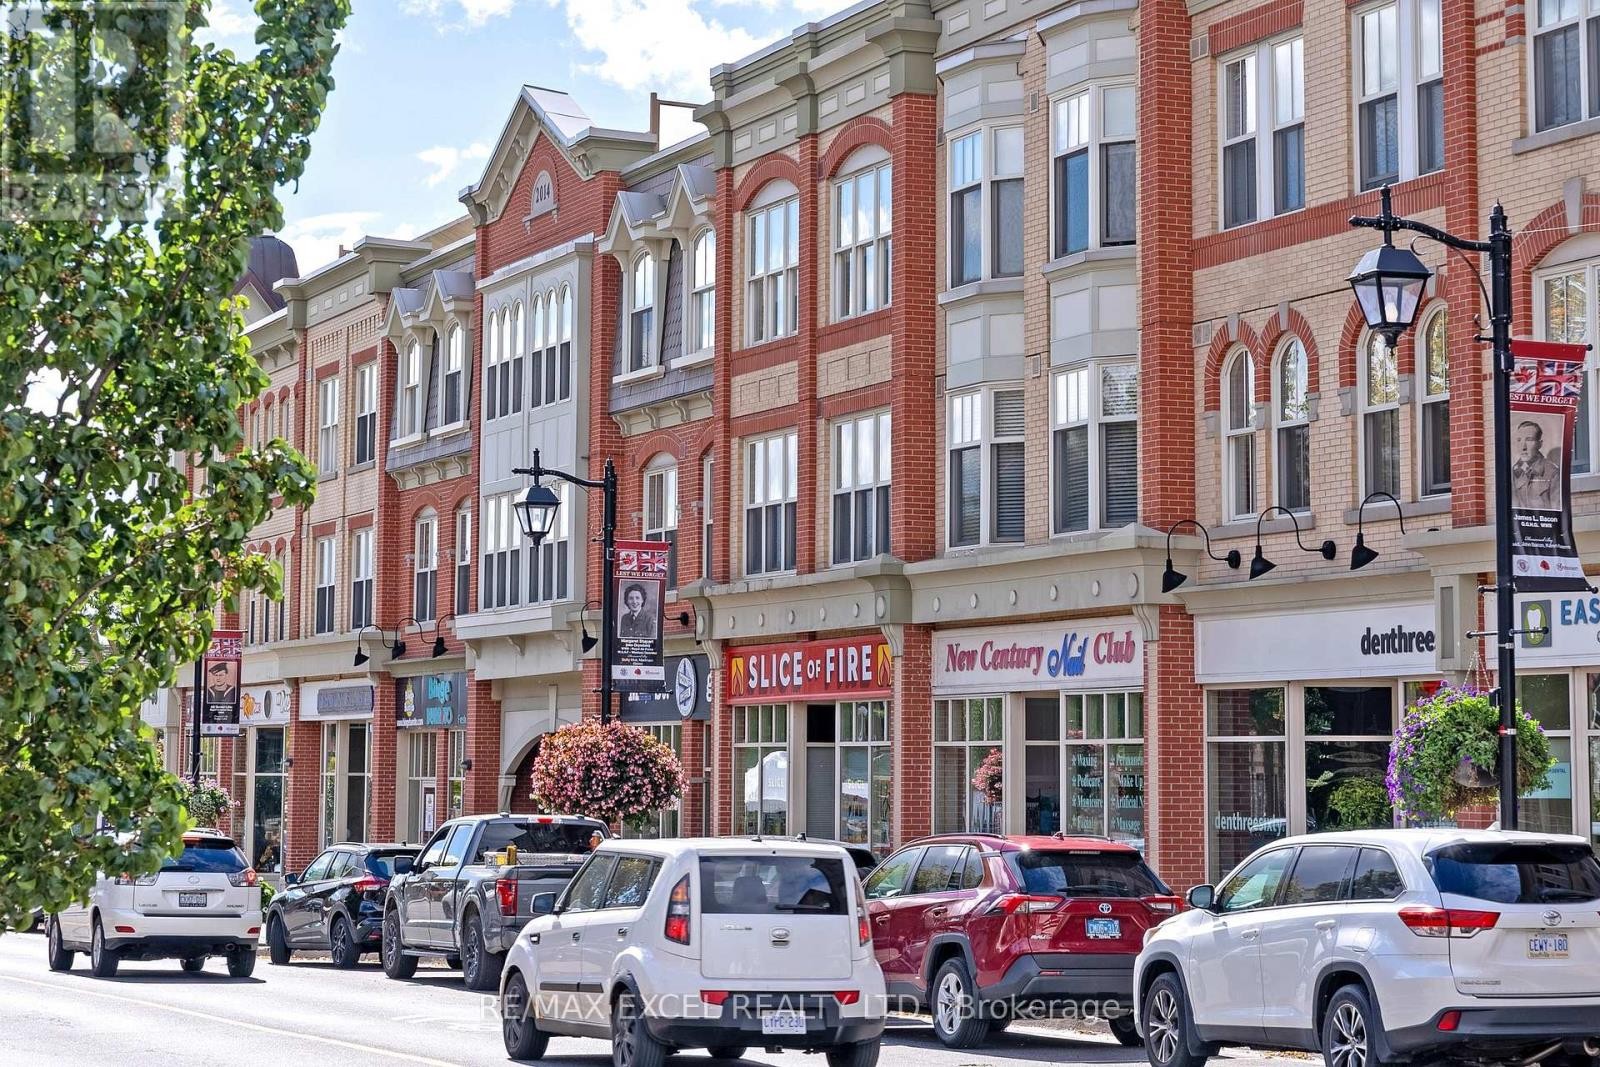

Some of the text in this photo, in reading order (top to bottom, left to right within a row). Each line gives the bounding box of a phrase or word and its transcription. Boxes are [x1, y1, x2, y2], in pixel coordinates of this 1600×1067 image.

[536, 182, 550, 203] 2014
[1526, 394, 1540, 402] WE
[1540, 395, 1574, 405] FORGET
[1513, 514, 1532, 522] James
[945, 630, 1136, 678] New Century Nail Club
[748, 652, 803, 689] SLICE
[807, 659, 821, 679] OF
[826, 645, 873, 684] FIRE
